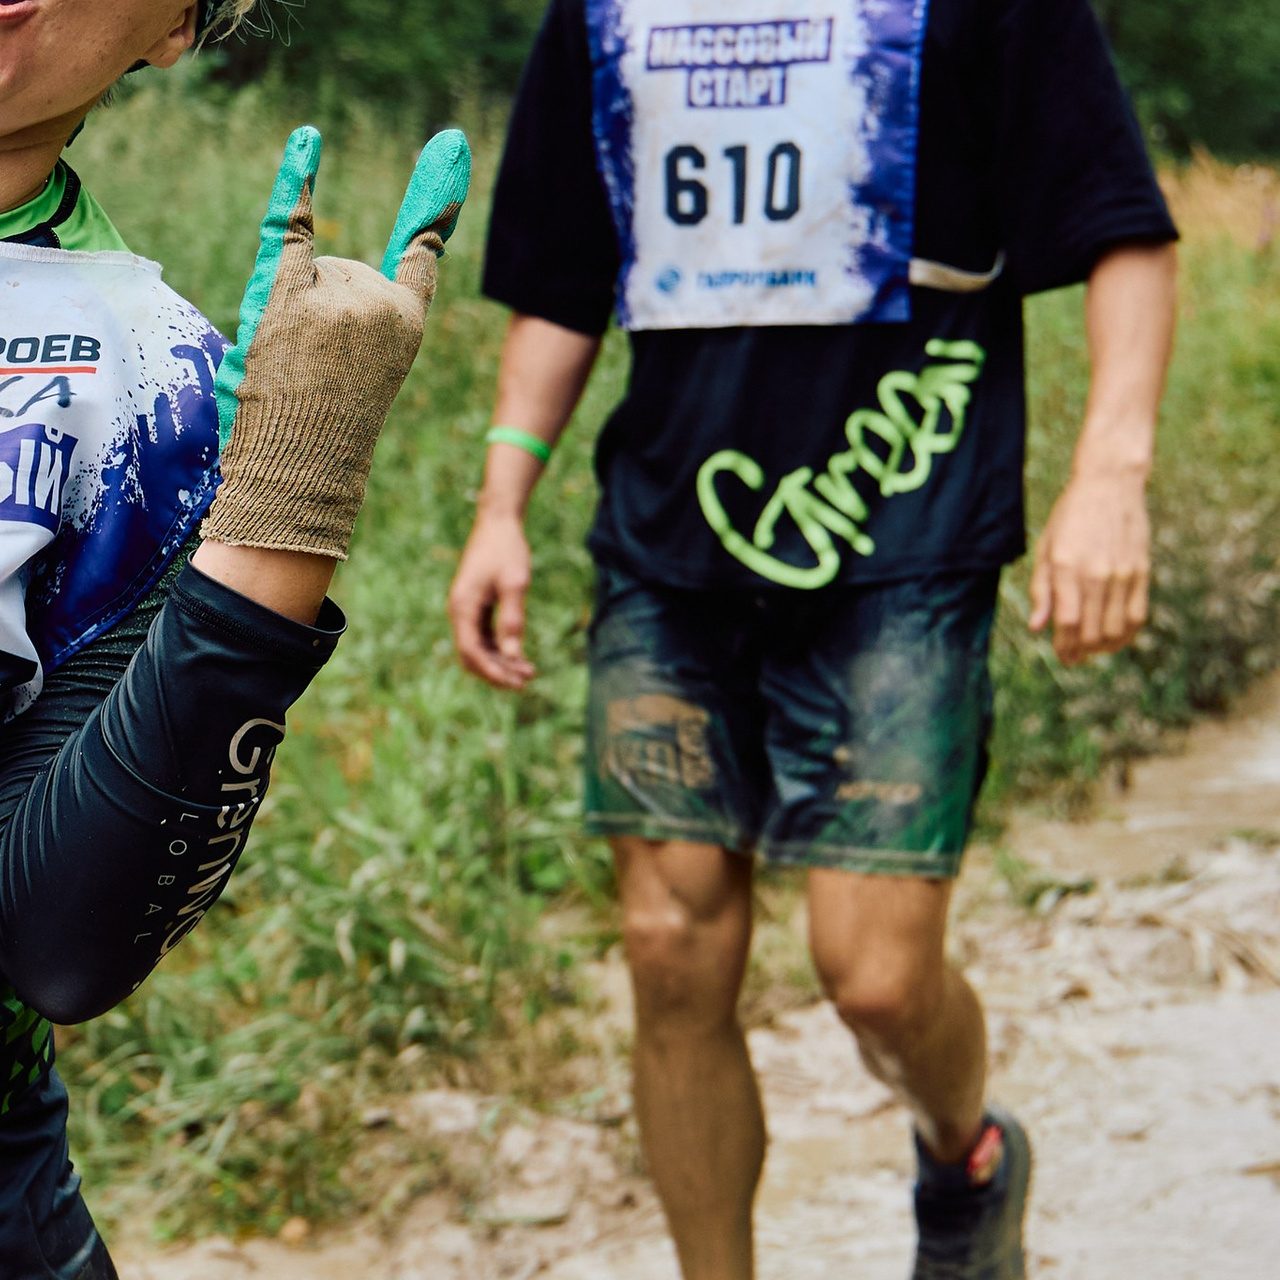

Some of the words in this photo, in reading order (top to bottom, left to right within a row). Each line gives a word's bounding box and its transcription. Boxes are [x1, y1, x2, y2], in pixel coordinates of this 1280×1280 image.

[650, 22, 828, 65] МАССОВЫЙ
[689, 68, 784, 107] СТАРТ
[664, 142, 801, 226] 610
